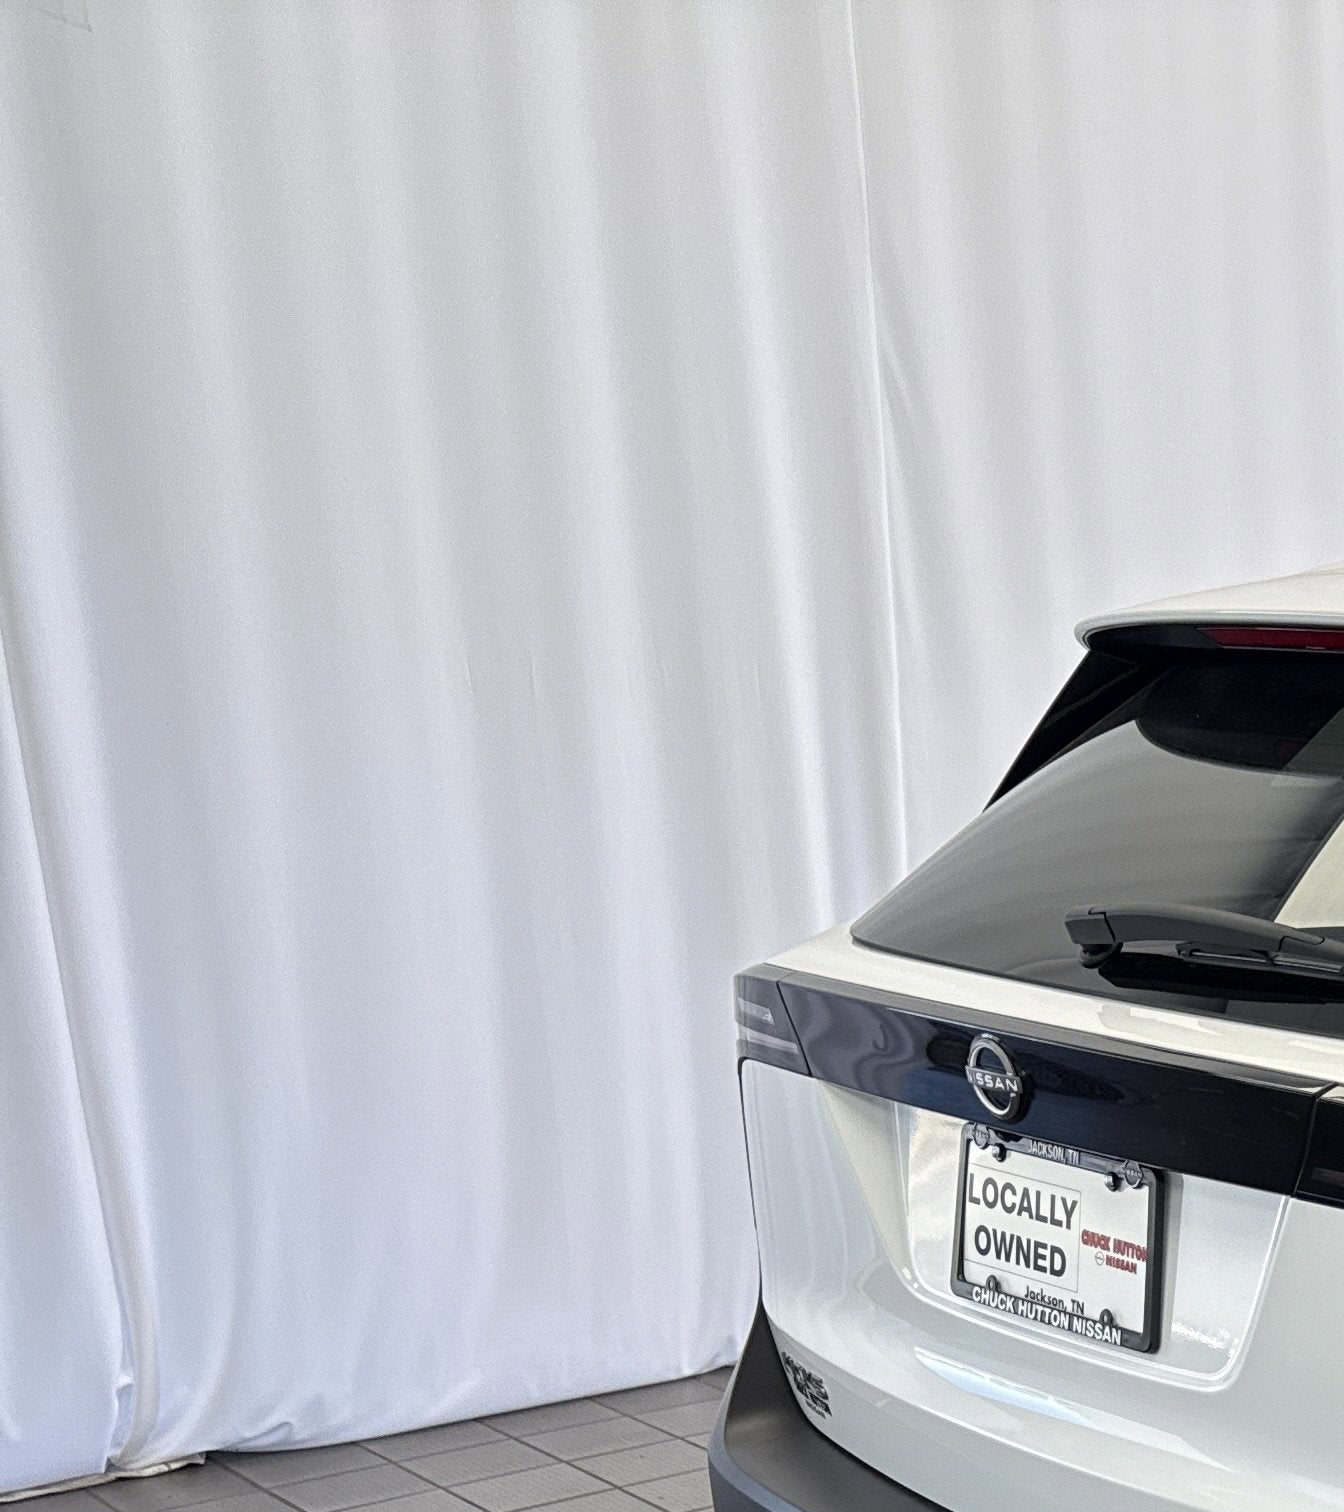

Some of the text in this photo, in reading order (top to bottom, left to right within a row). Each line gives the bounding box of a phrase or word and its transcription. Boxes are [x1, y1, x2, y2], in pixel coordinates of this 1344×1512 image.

[966, 1069, 1019, 1092] NISSAN
[1028, 1139, 1081, 1165] JACKSON, TN
[968, 1173, 1078, 1230] LOCALLY
[974, 1225, 1067, 1277] OWNED
[1081, 1228, 1148, 1262] CHUCK HUTTON
[1105, 1254, 1138, 1275] NISSAN
[972, 1286, 1122, 1346] CHUCK HUTTON NISSAN
[1024, 1285, 1085, 1315] Jackson, TN
